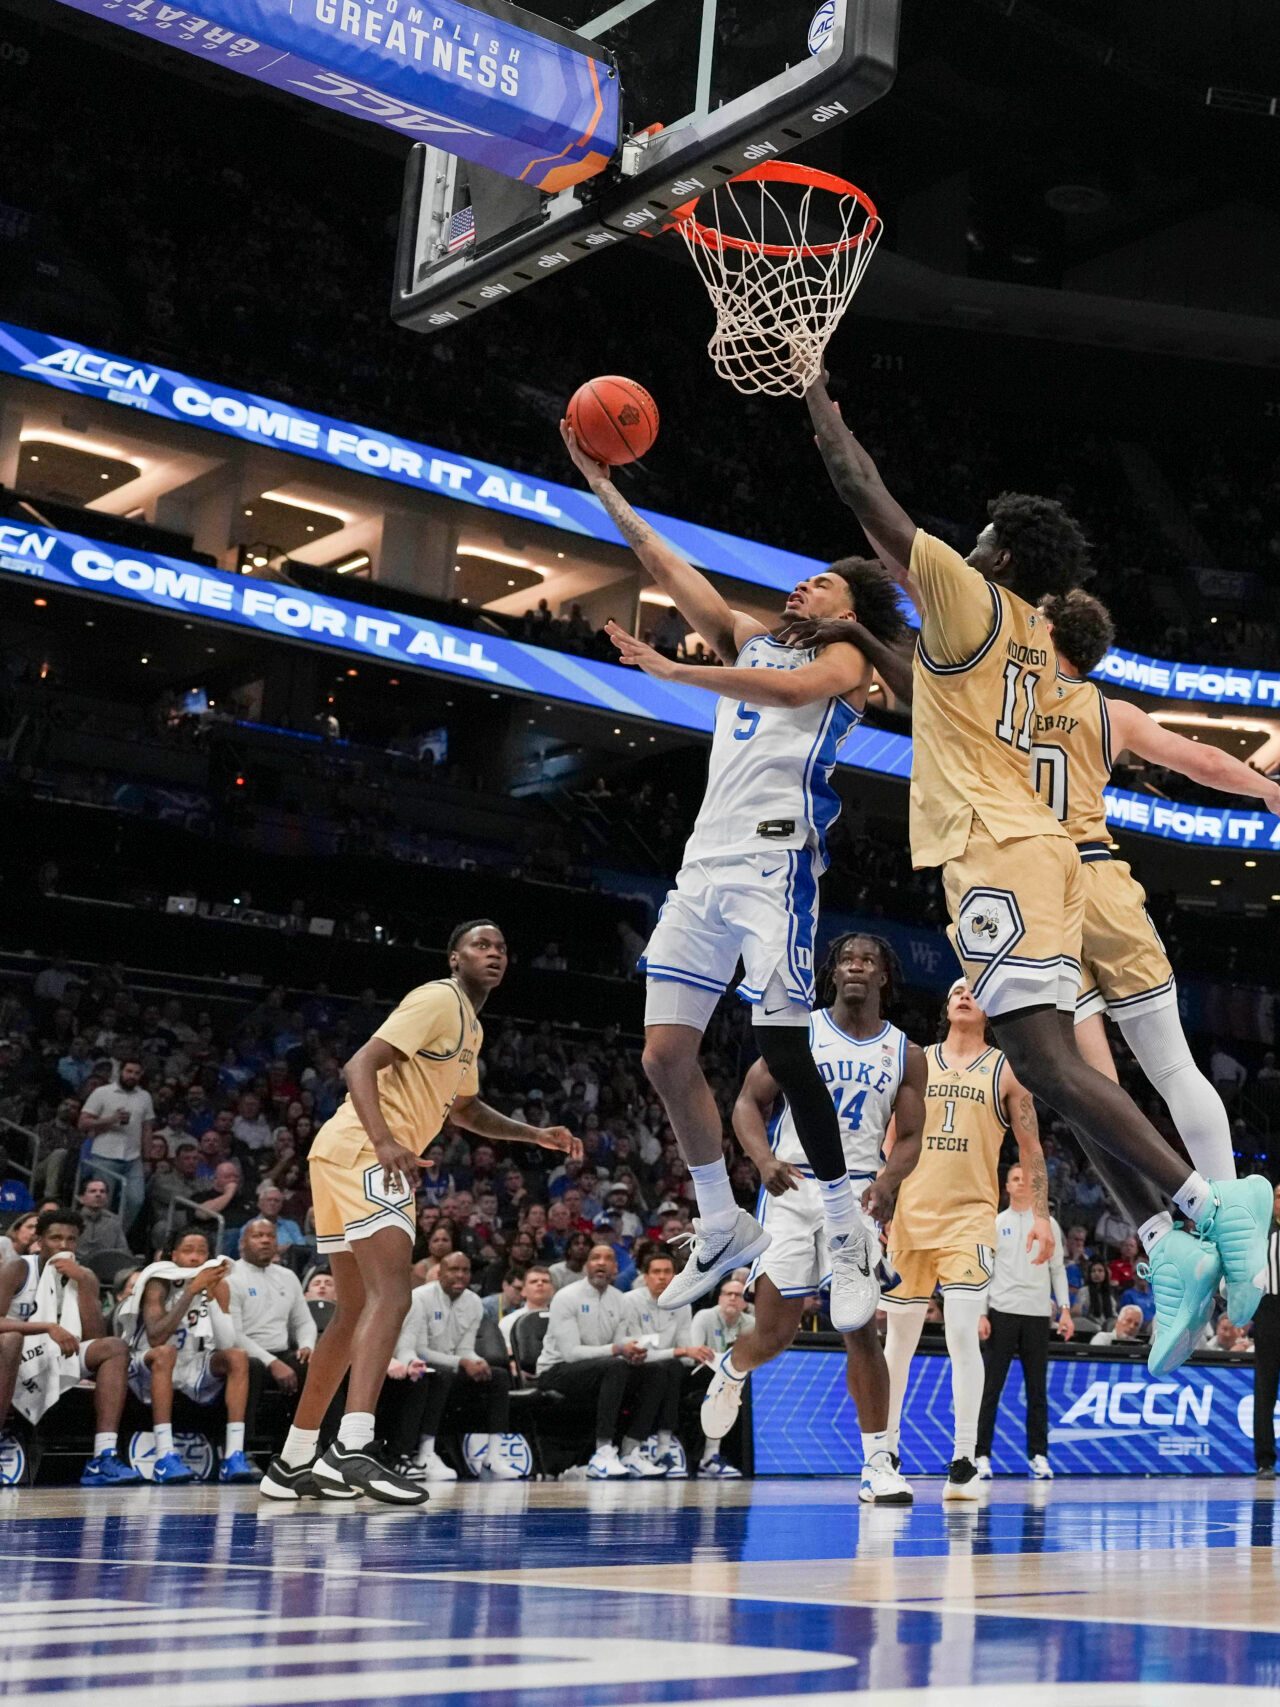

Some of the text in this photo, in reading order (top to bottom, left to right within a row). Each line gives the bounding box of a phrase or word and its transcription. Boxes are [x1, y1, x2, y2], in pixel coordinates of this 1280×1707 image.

[117, 0, 261, 53] GREAT
[315, 0, 519, 97] GREATNESS
[365, 0, 520, 64] OMPLISH
[427, 99, 850, 328] ally ally ally ally ally ally ally ally
[37, 348, 160, 396] ACCN
[172, 387, 320, 449] COME
[327, 428, 424, 479] FOR
[429, 458, 472, 490] IT
[477, 478, 561, 518] ALL
[0, 526, 57, 560] CN
[71, 551, 234, 611] COME
[241, 587, 348, 637] FOR
[355, 616, 400, 648] IT
[407, 631, 498, 672] ALL
[996, 659, 1040, 754] 11
[1174, 672, 1252, 698] FOR
[733, 697, 761, 741] 5
[1035, 712, 1079, 735] ERRY
[1103, 796, 1152, 823] ME
[1152, 809, 1222, 838] FOR
[1227, 819, 1264, 841] IT
[818, 1060, 893, 1095] DUKE
[928, 1084, 986, 1105] EORGIA
[833, 1087, 868, 1131] 14
[942, 1100, 956, 1134] 1
[926, 1136, 969, 1152] TECH
[1059, 1382, 1213, 1425] ACCN
